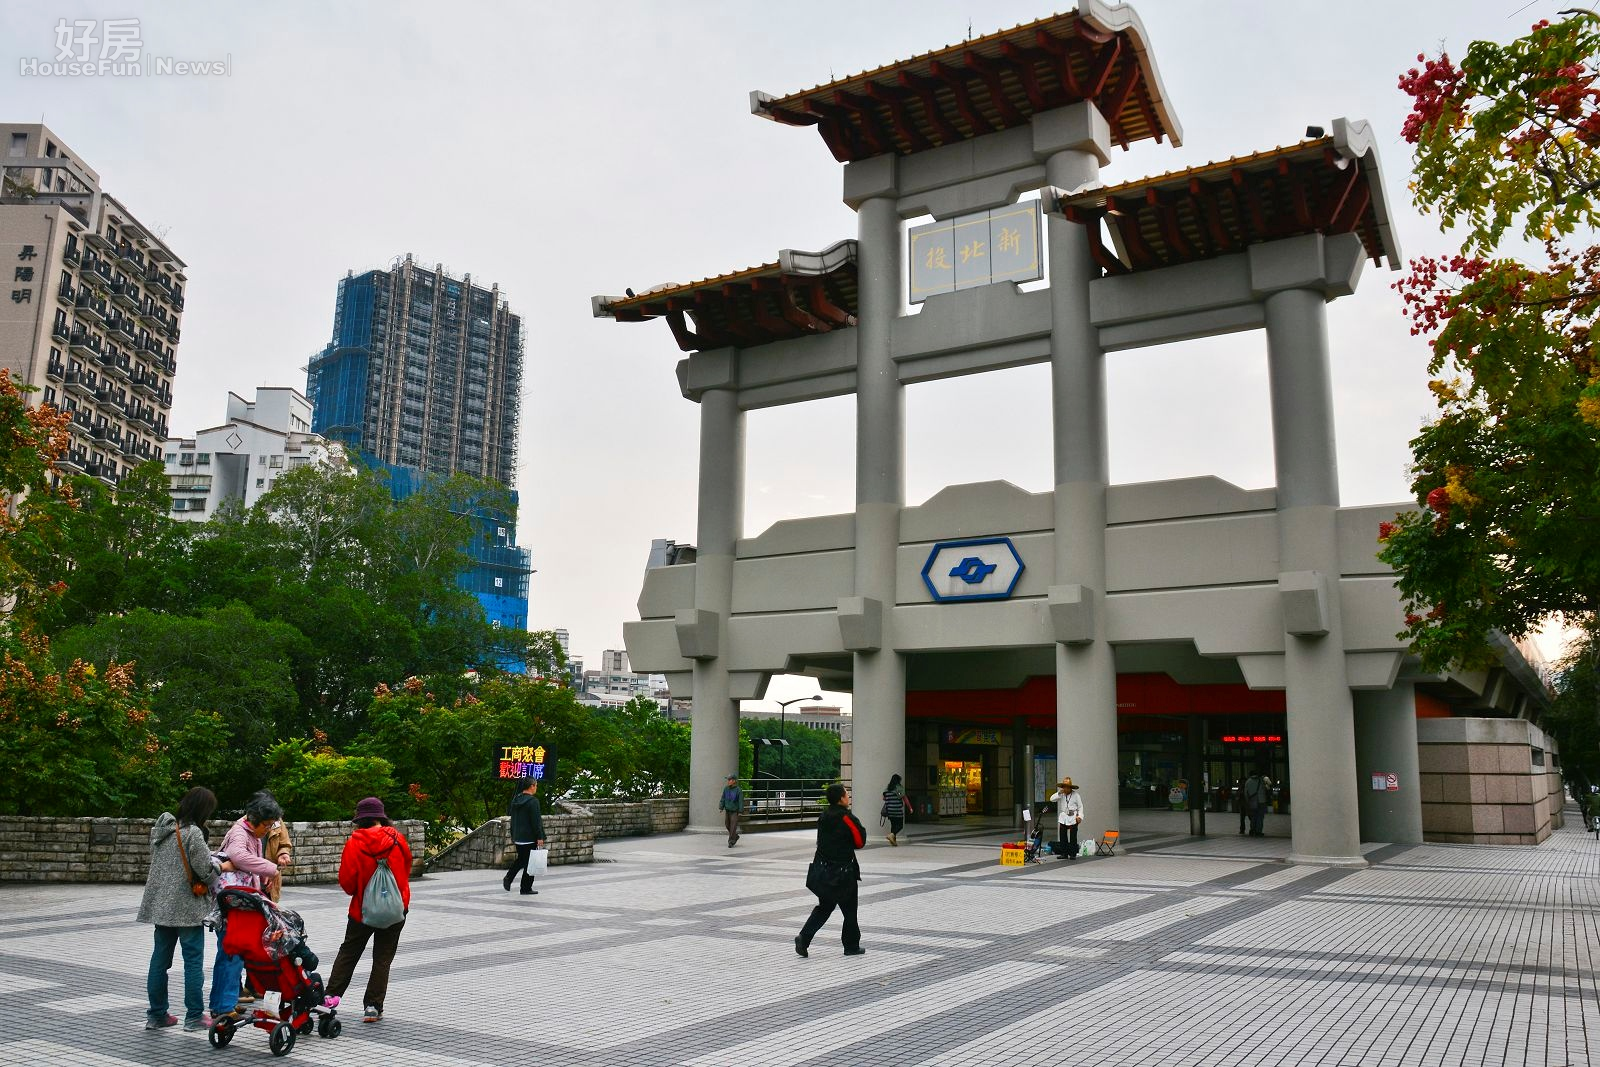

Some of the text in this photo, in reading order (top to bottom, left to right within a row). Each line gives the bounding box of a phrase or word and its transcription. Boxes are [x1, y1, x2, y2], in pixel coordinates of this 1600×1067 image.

[500, 746, 546, 763] 工商聚會
[500, 762, 545, 779] 歡迎訂席
